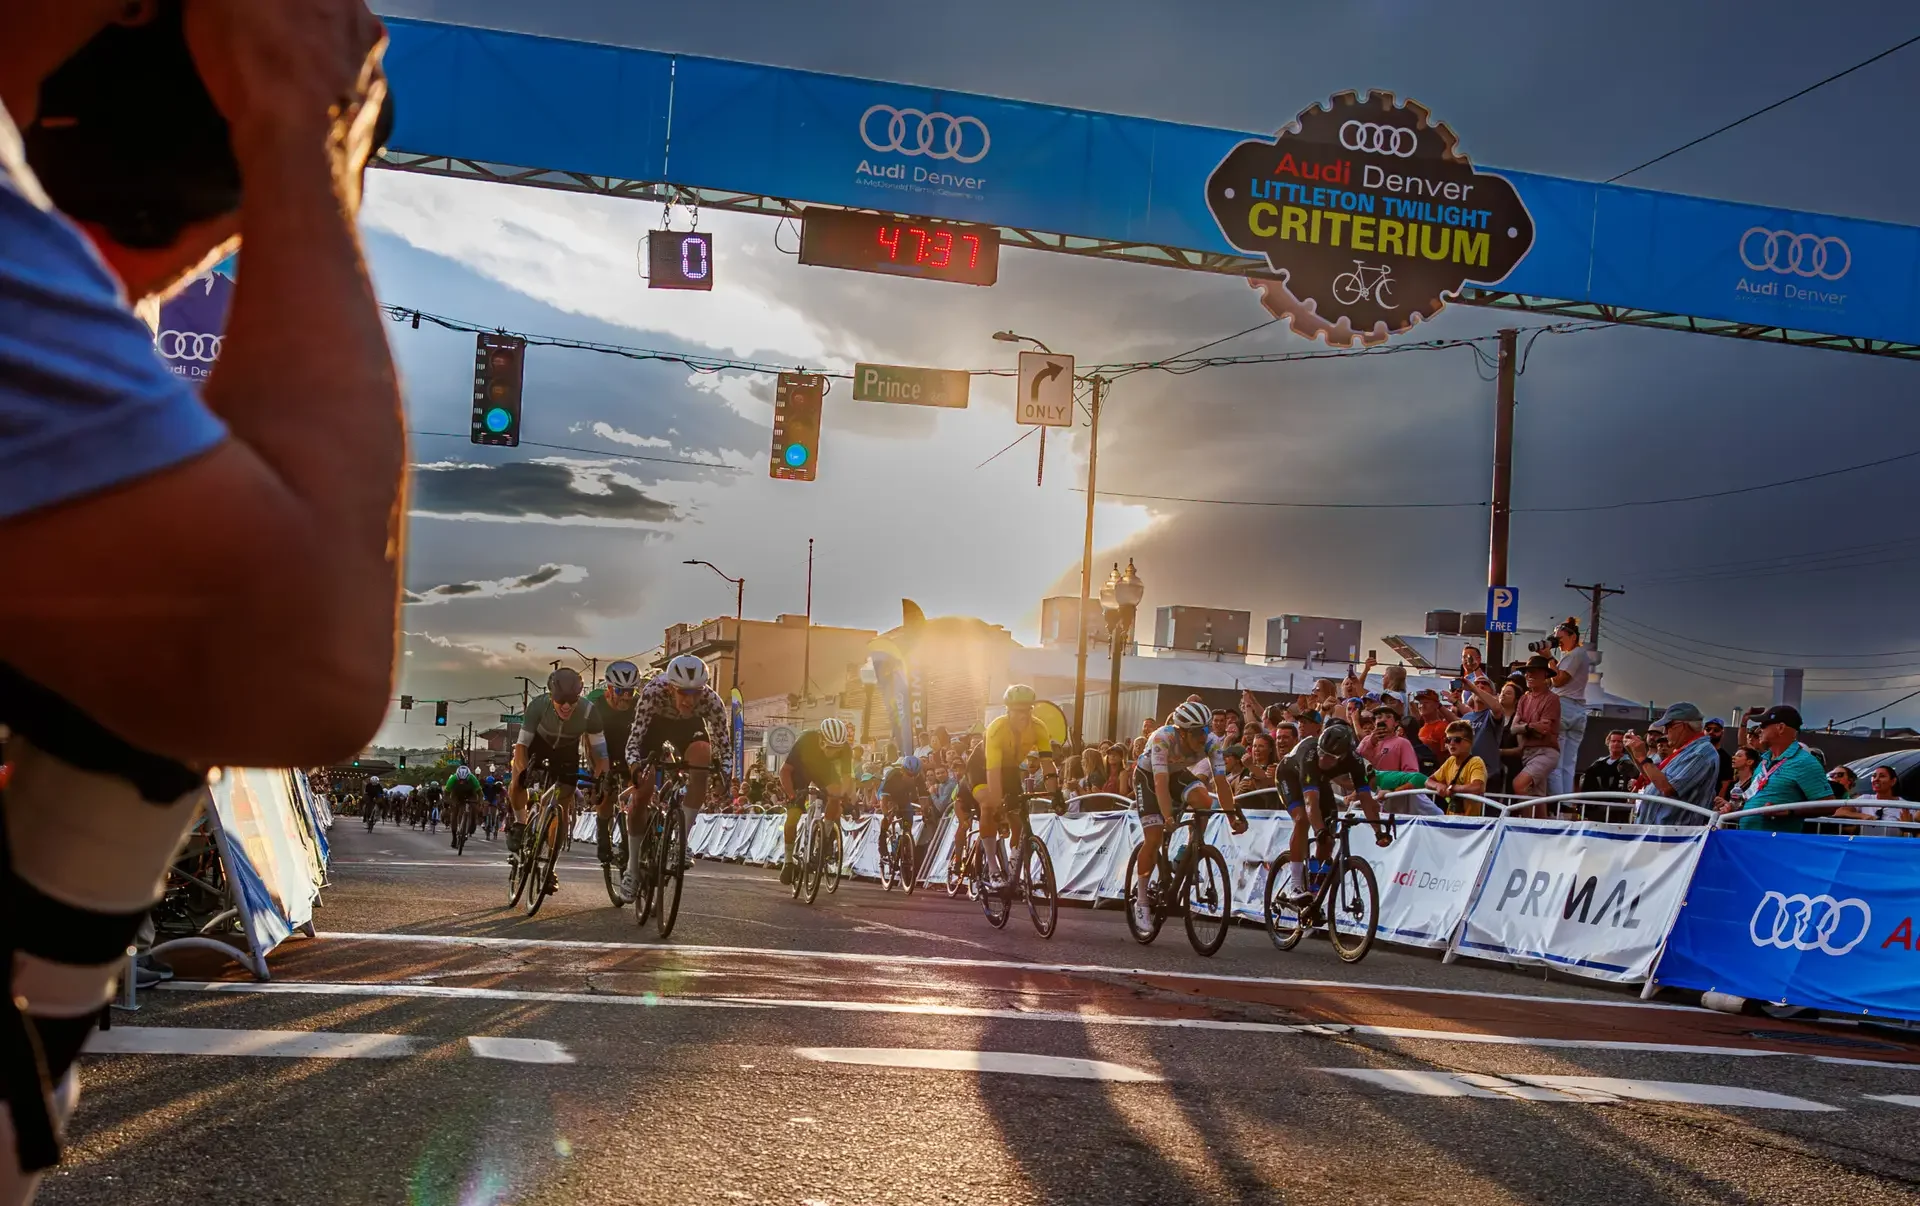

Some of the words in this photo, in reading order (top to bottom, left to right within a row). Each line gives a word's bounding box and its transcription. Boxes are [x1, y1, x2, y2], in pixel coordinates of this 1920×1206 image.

[856, 160, 905, 179] Audi
[913, 167, 986, 189] Denver
[1274, 153, 1350, 184] Audi
[1363, 165, 1474, 201] Denver
[1251, 178, 1375, 214] LITTLETON
[1382, 197, 1492, 229] TWILIGHT
[879, 227, 980, 269] 47:37
[1248, 202, 1490, 267] CRITERIUM
[682, 237, 707, 279] 0
[1736, 278, 1779, 296] Audi
[1785, 285, 1847, 305] Denver
[863, 369, 921, 399] Prince
[1025, 404, 1066, 420] ONLY
[1492, 588, 1513, 620] P
[1490, 621, 1513, 631] FREE
[1393, 869, 1418, 887] di
[1418, 872, 1466, 893] Denver
[1496, 868, 1646, 929] PRIMAL
[1880, 916, 1920, 951] A
